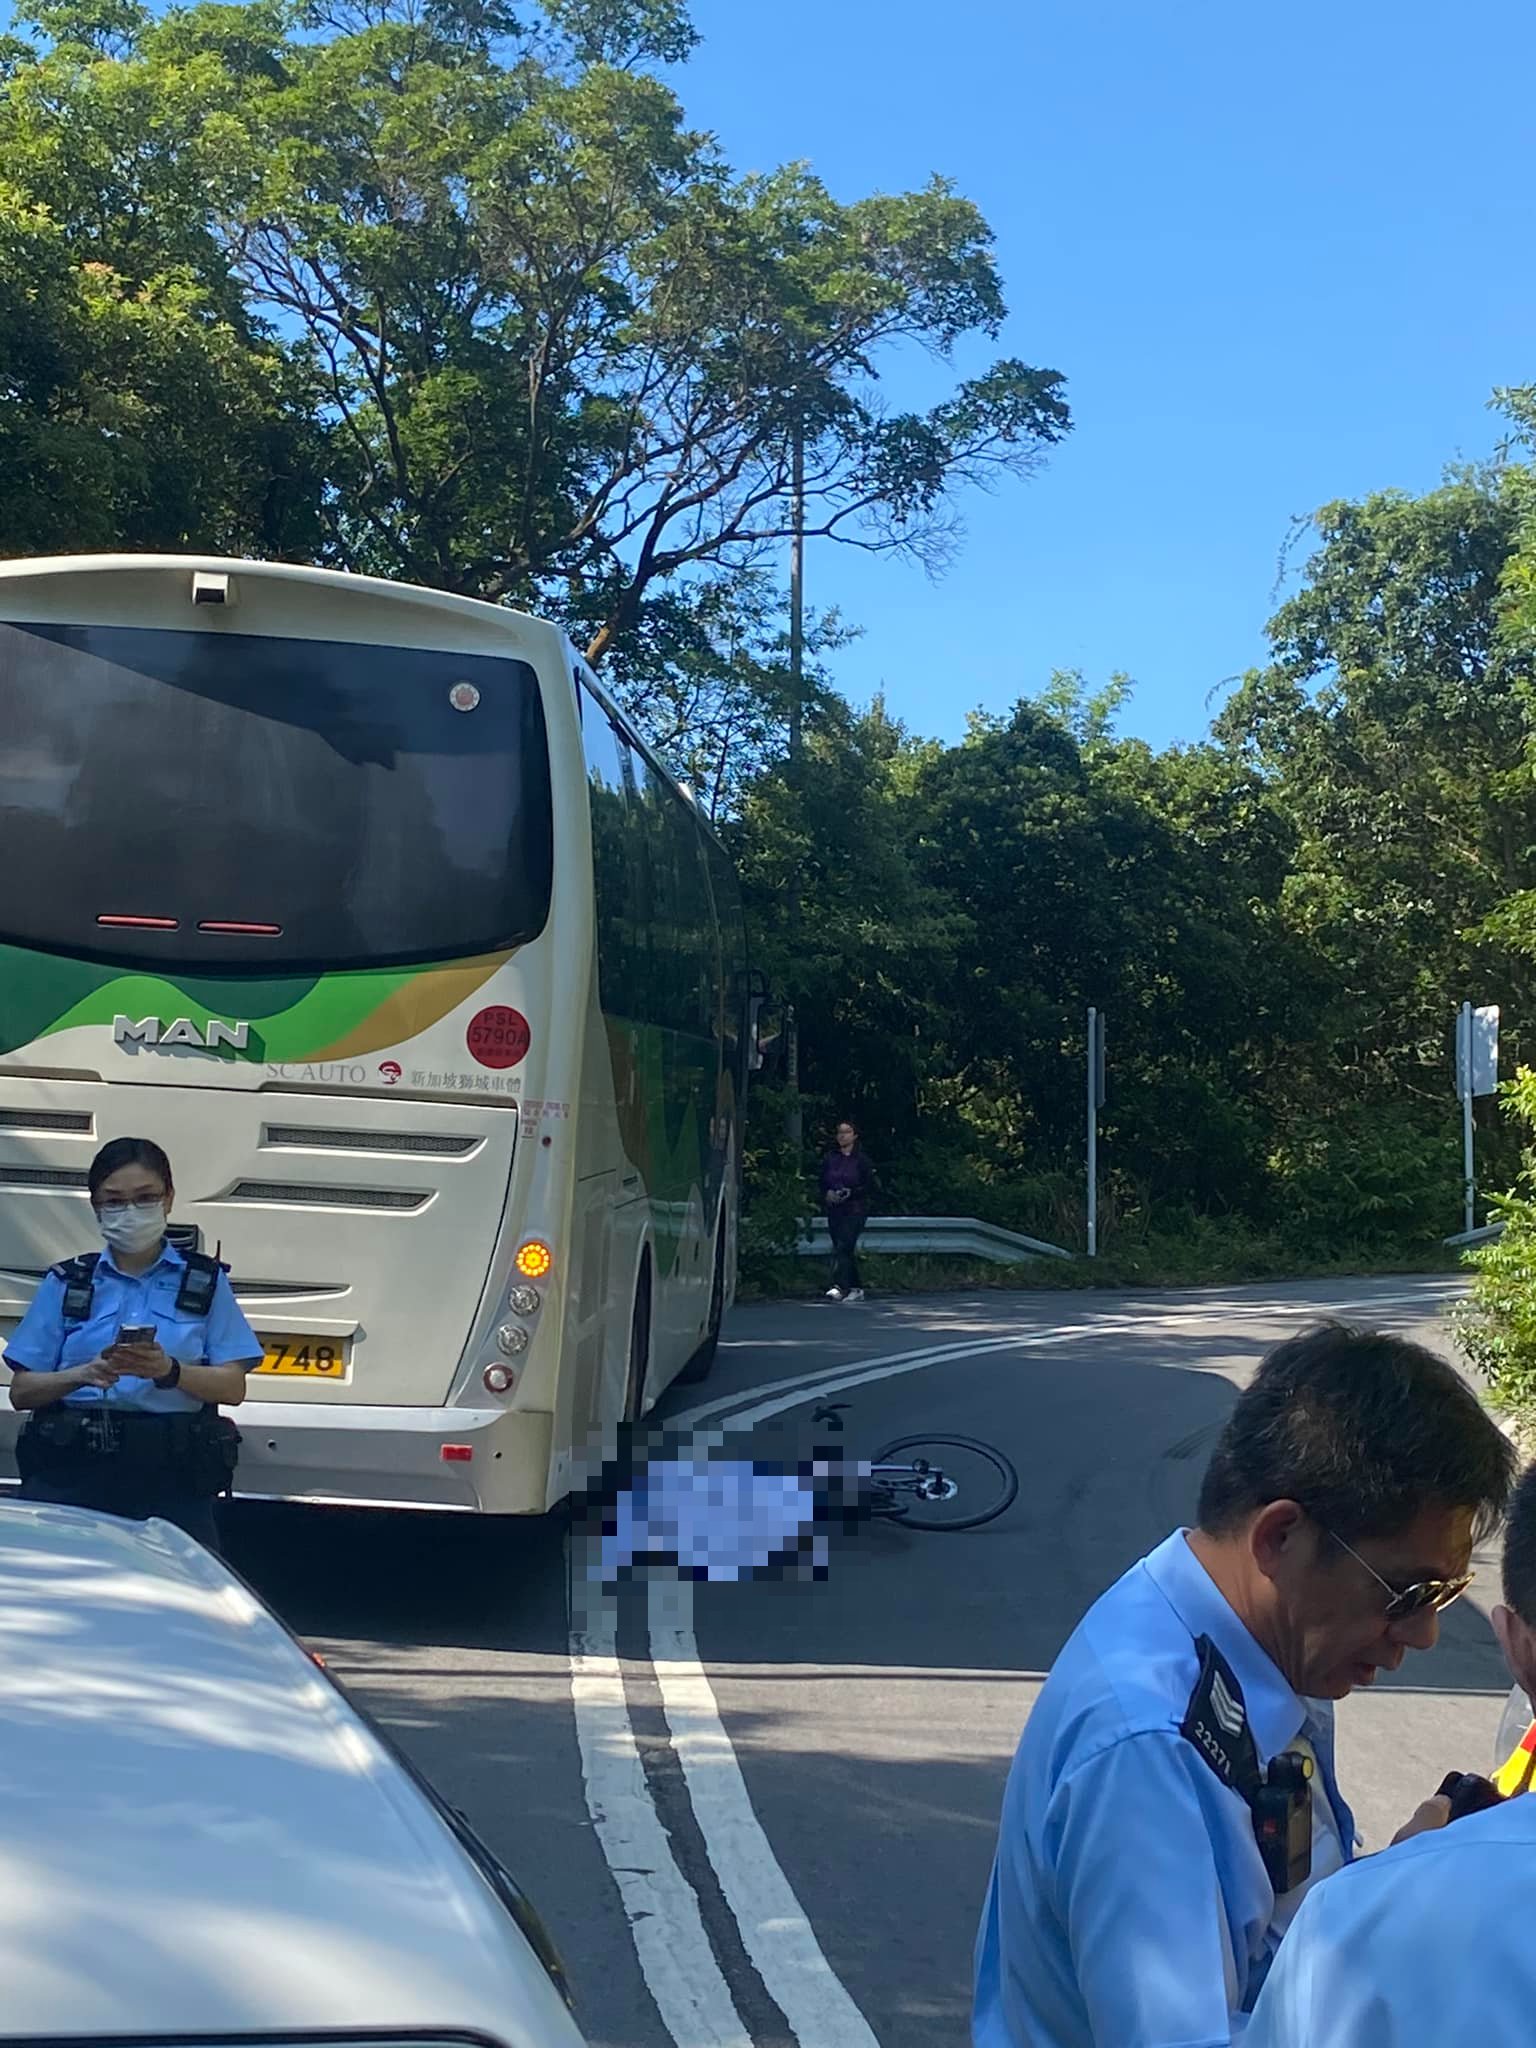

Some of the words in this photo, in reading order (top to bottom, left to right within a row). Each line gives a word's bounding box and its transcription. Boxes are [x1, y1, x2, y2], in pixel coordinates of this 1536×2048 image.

[484, 1011, 519, 1026] PSL
[112, 1014, 249, 1049] MAN
[265, 1063, 294, 1079] SC
[301, 1064, 366, 1083] AUTO
[257, 1343, 335, 1372] 748
